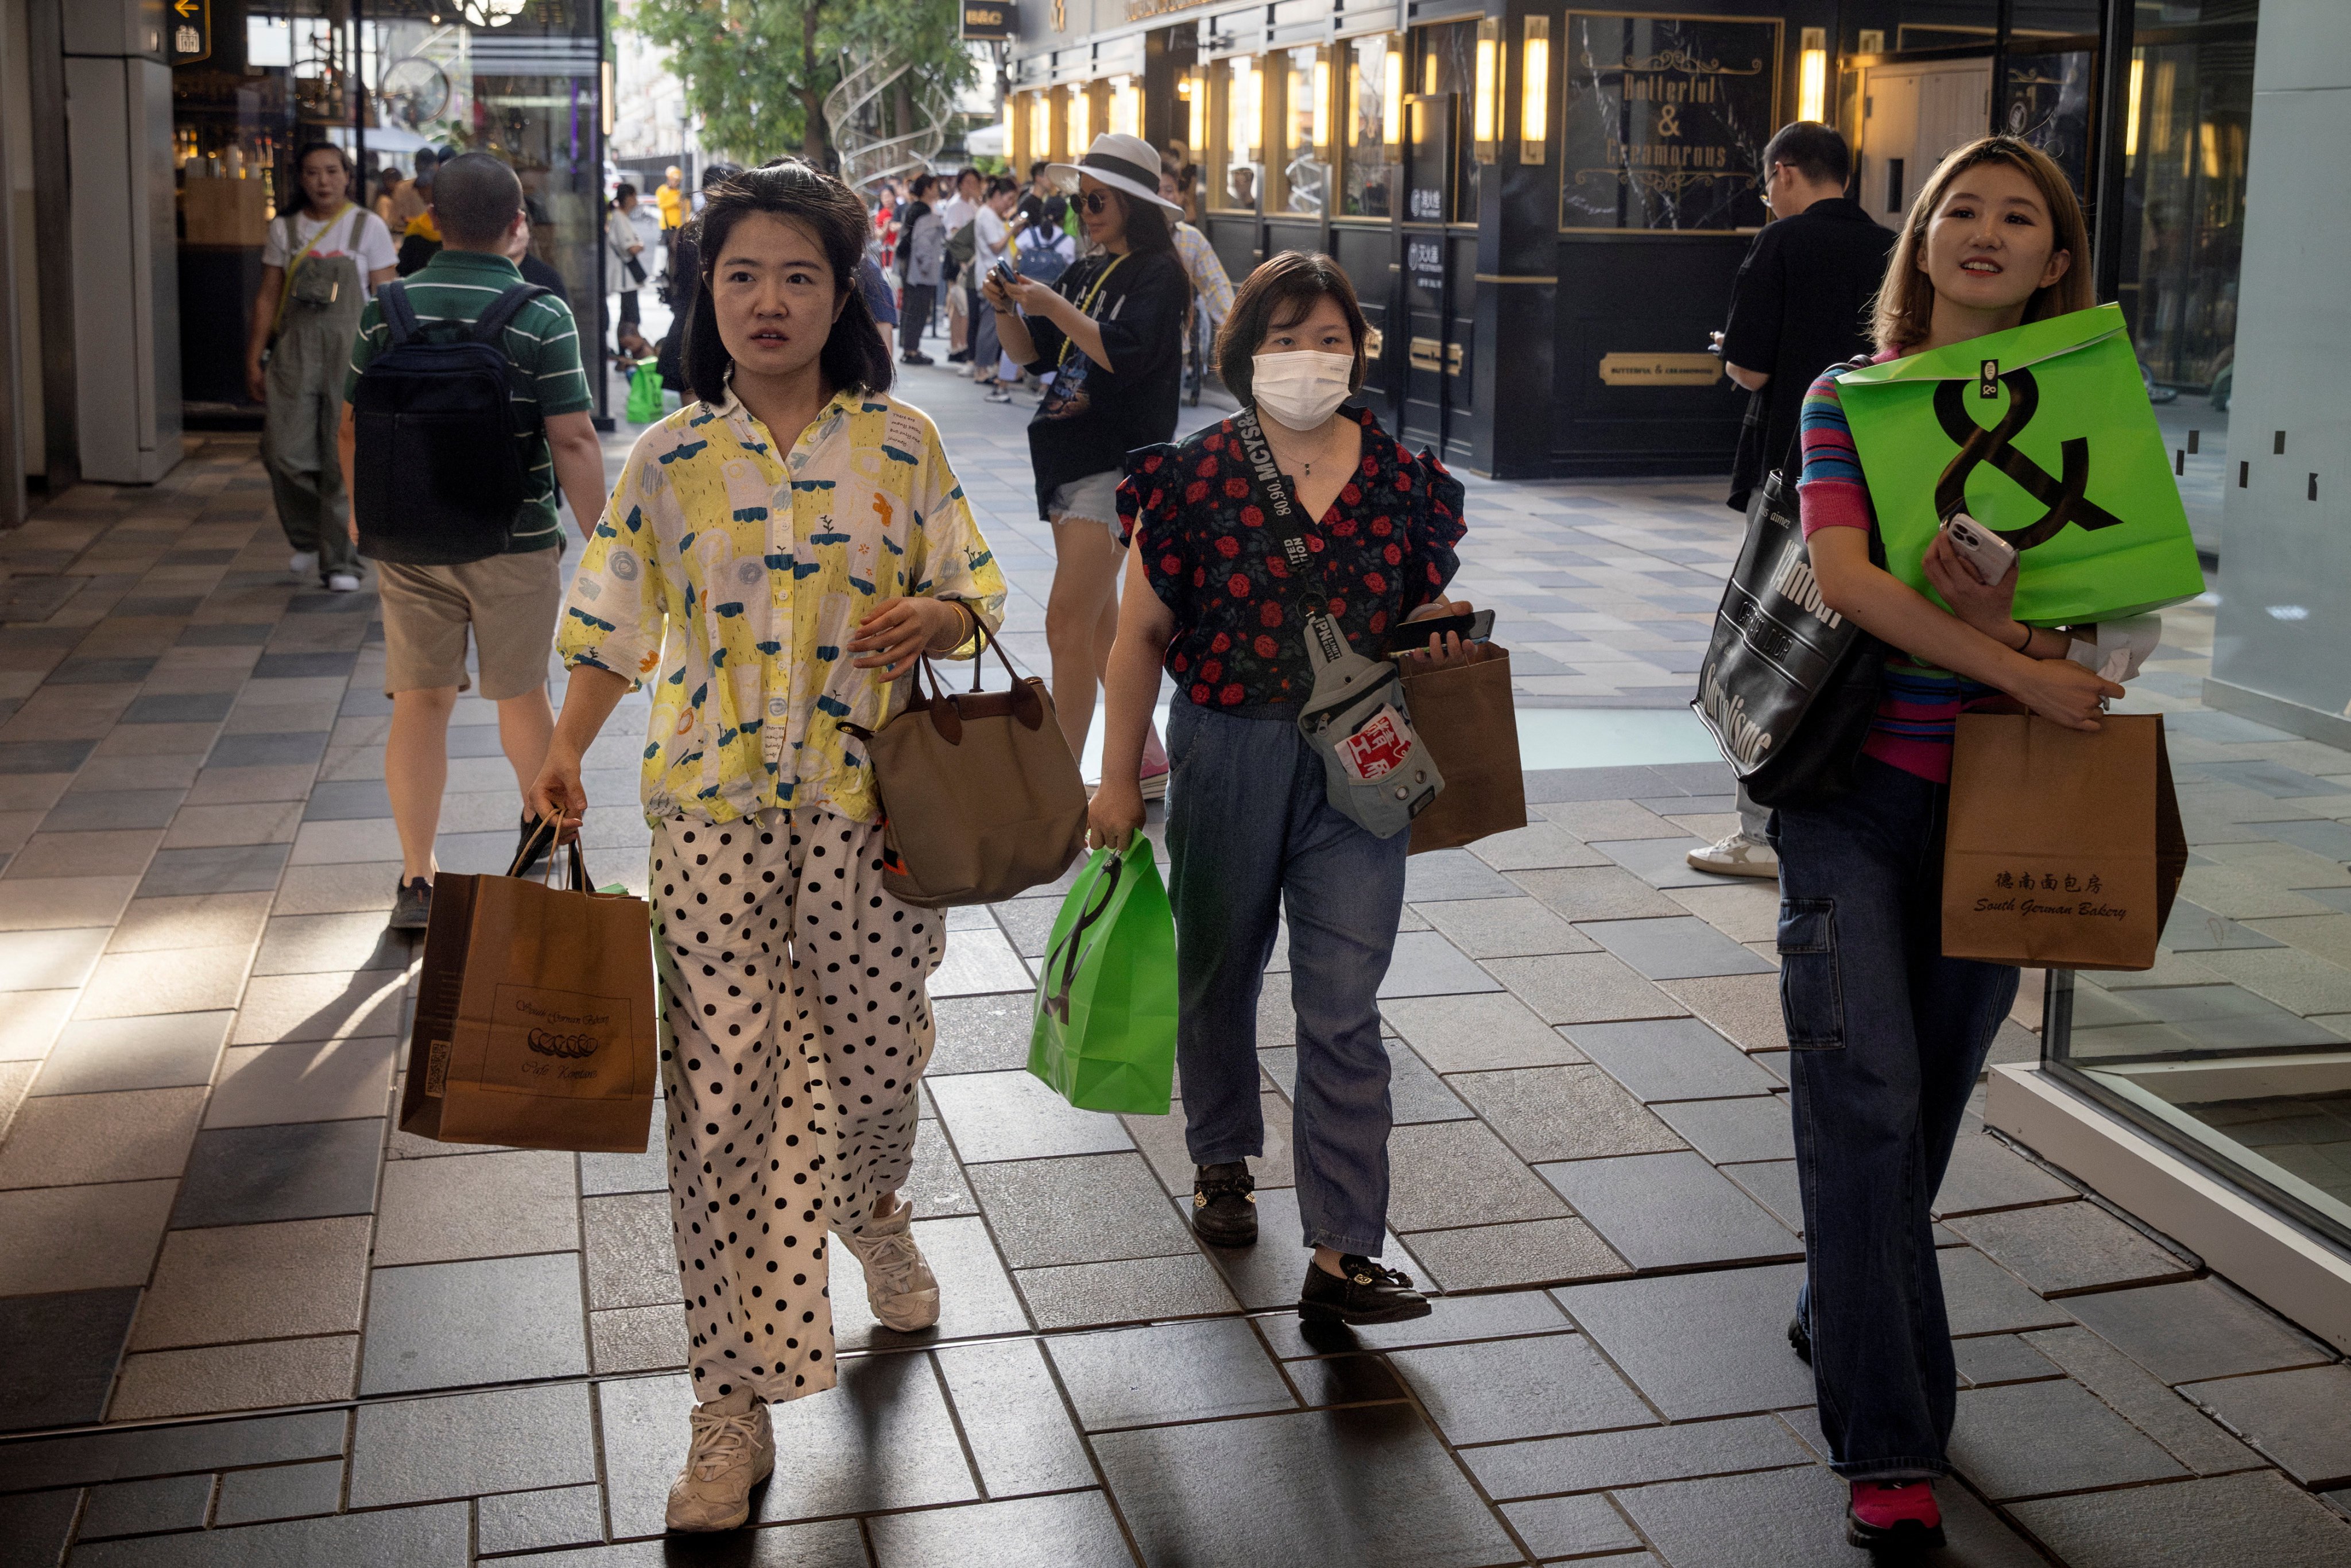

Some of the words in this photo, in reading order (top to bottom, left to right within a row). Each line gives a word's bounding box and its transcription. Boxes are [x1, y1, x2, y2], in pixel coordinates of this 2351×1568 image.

[1658, 104, 1682, 137] &
[1974, 898, 2016, 912] South
[2020, 899, 2073, 916] German
[2078, 902, 2127, 922] Bakery
